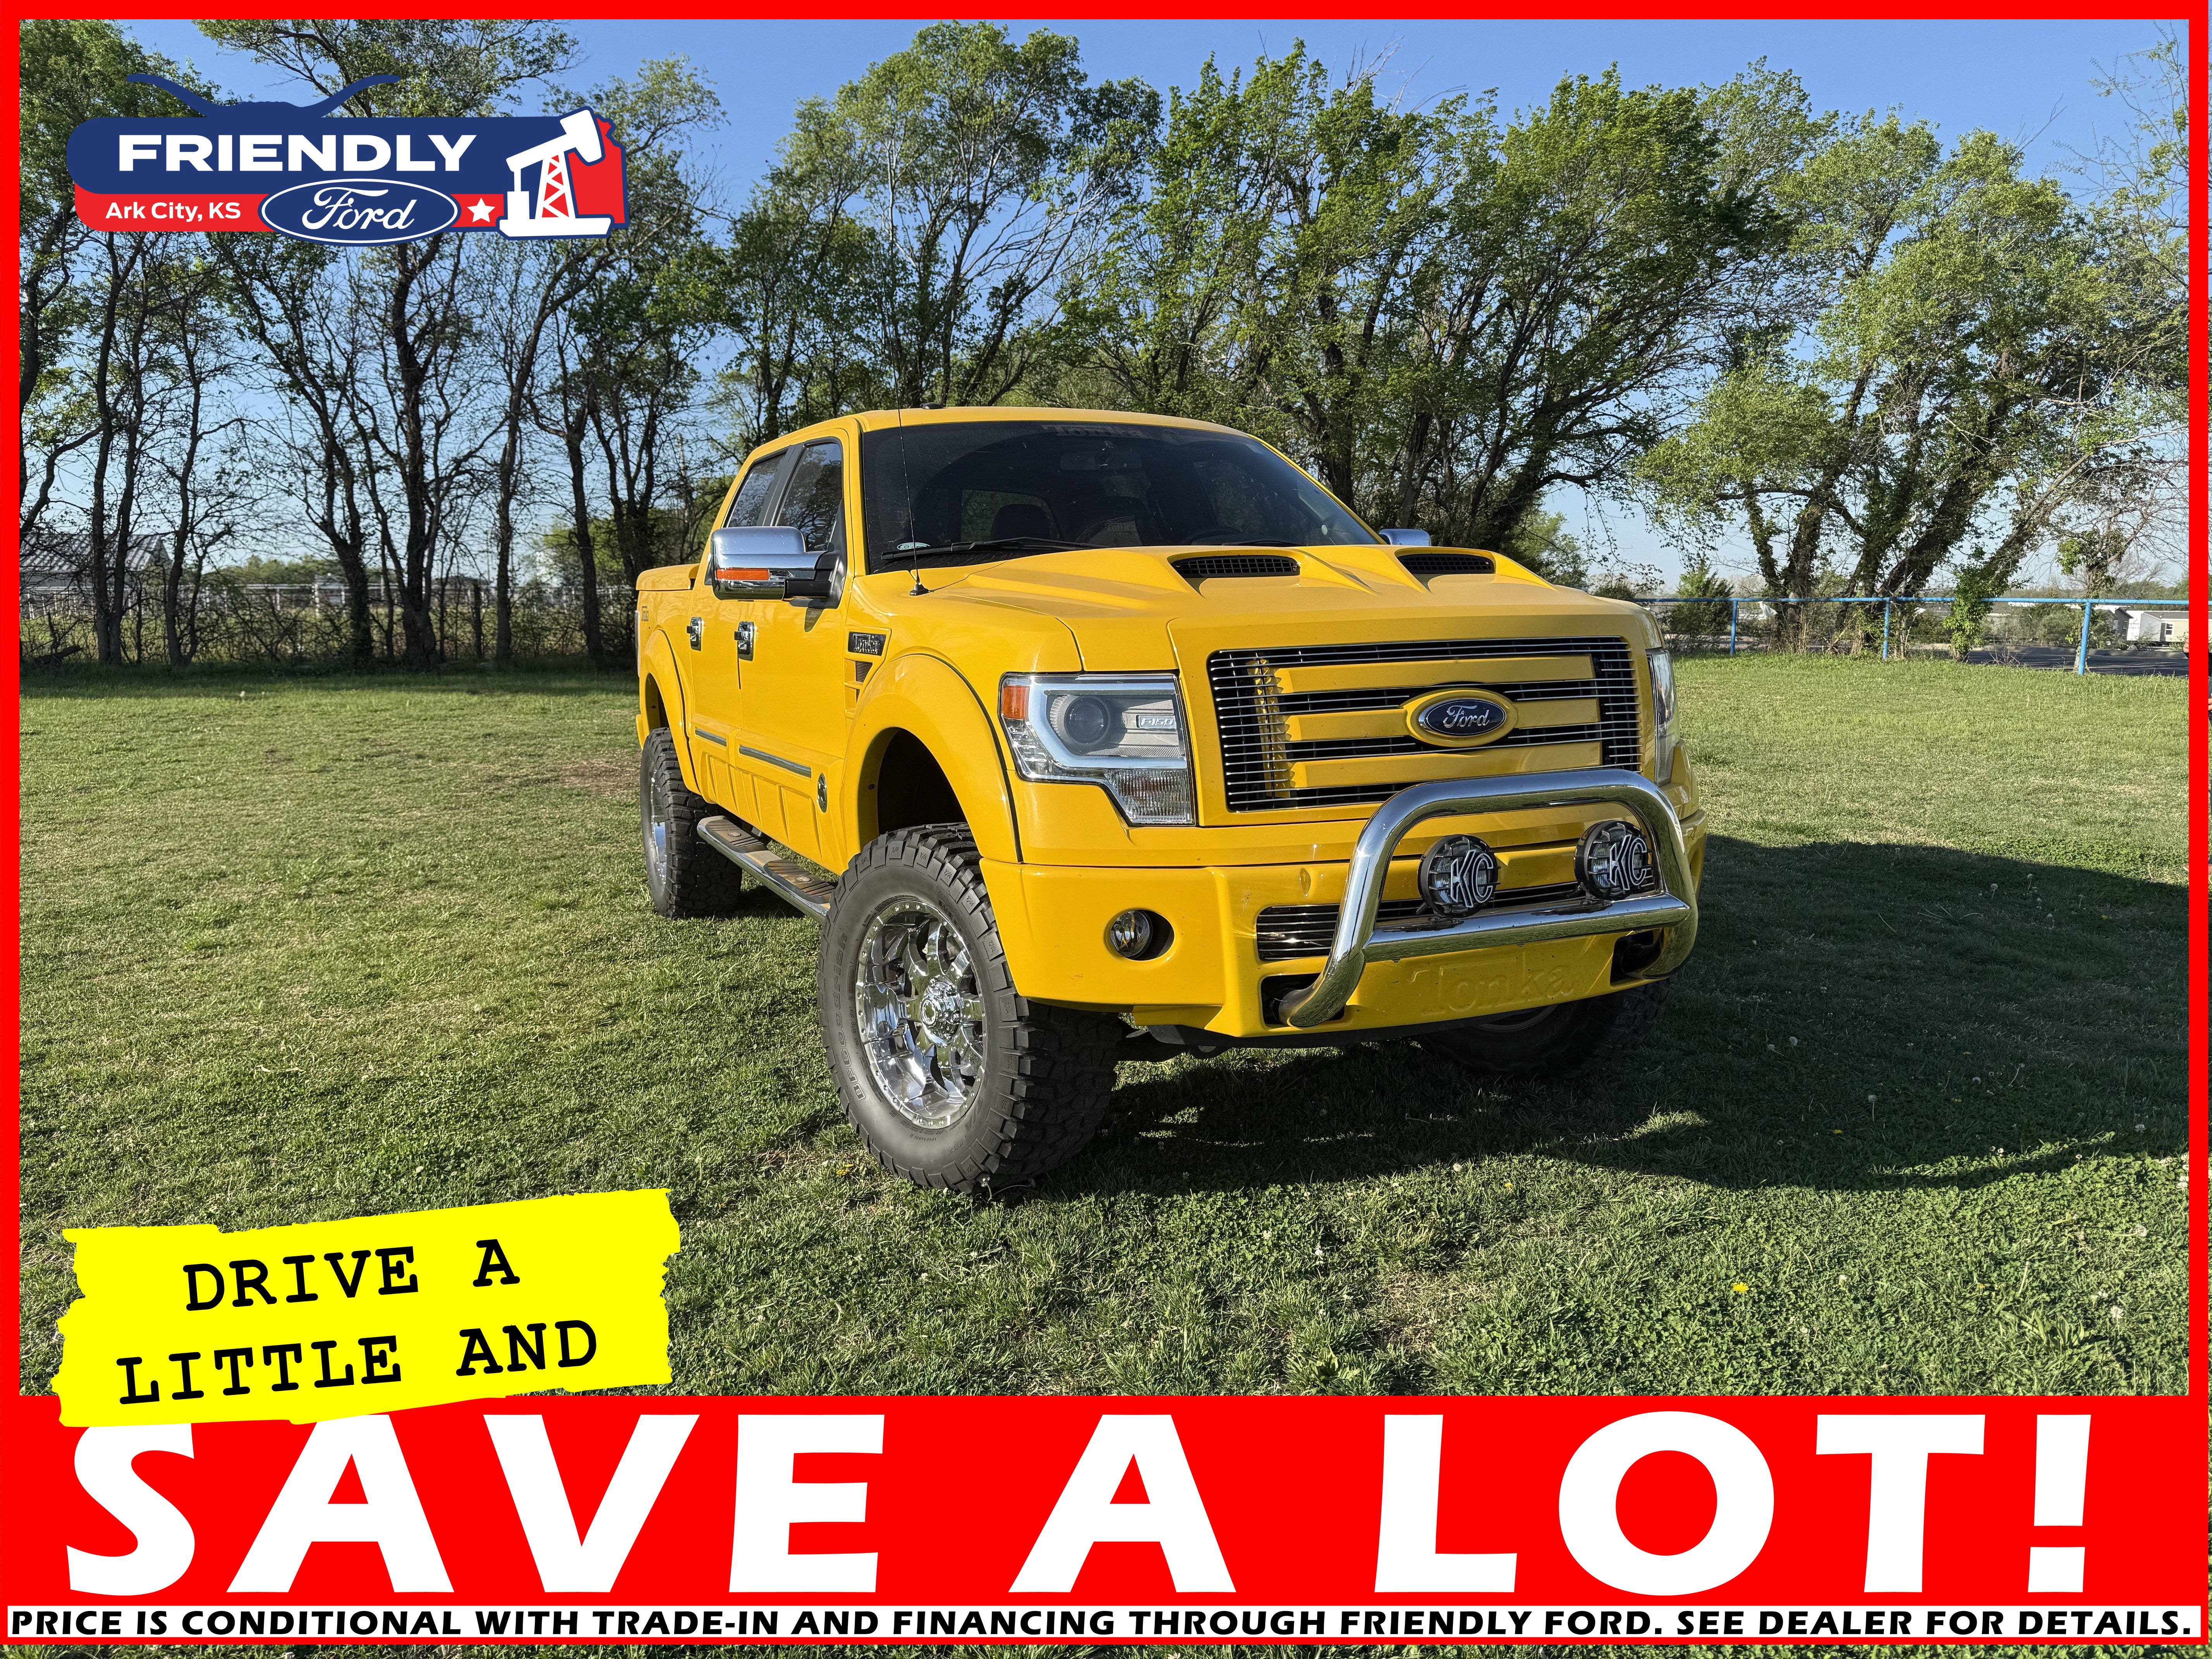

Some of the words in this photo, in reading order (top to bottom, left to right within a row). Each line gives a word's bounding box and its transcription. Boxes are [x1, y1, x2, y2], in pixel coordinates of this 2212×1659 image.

[1443, 705, 1490, 728] Ford
[1450, 849, 1494, 908] KC
[1610, 834, 1647, 891] KC
[1407, 951, 1575, 1015] Tonka
[833, 933, 866, 1101] BFGoodrich
